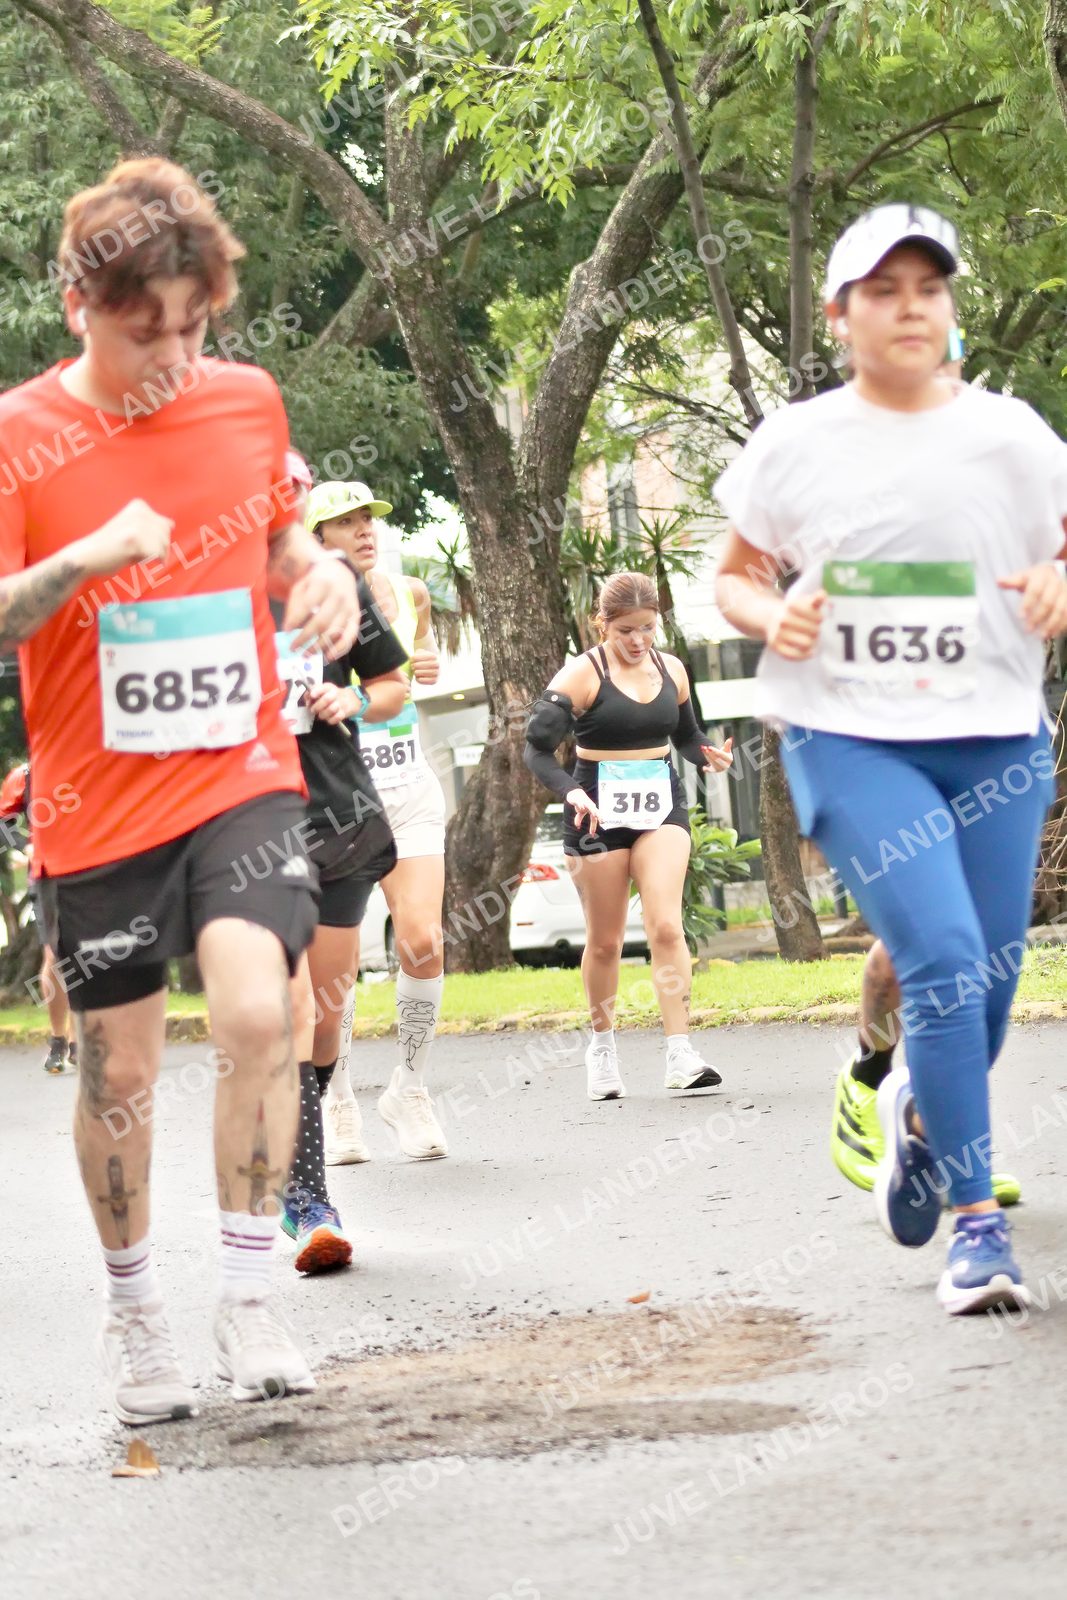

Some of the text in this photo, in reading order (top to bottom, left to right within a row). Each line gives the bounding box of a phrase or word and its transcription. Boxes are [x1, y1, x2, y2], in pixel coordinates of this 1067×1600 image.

[837, 625, 965, 663] 1636
[116, 662, 250, 714] 6852
[360, 740, 415, 770] 6861
[613, 792, 660, 813] 318
